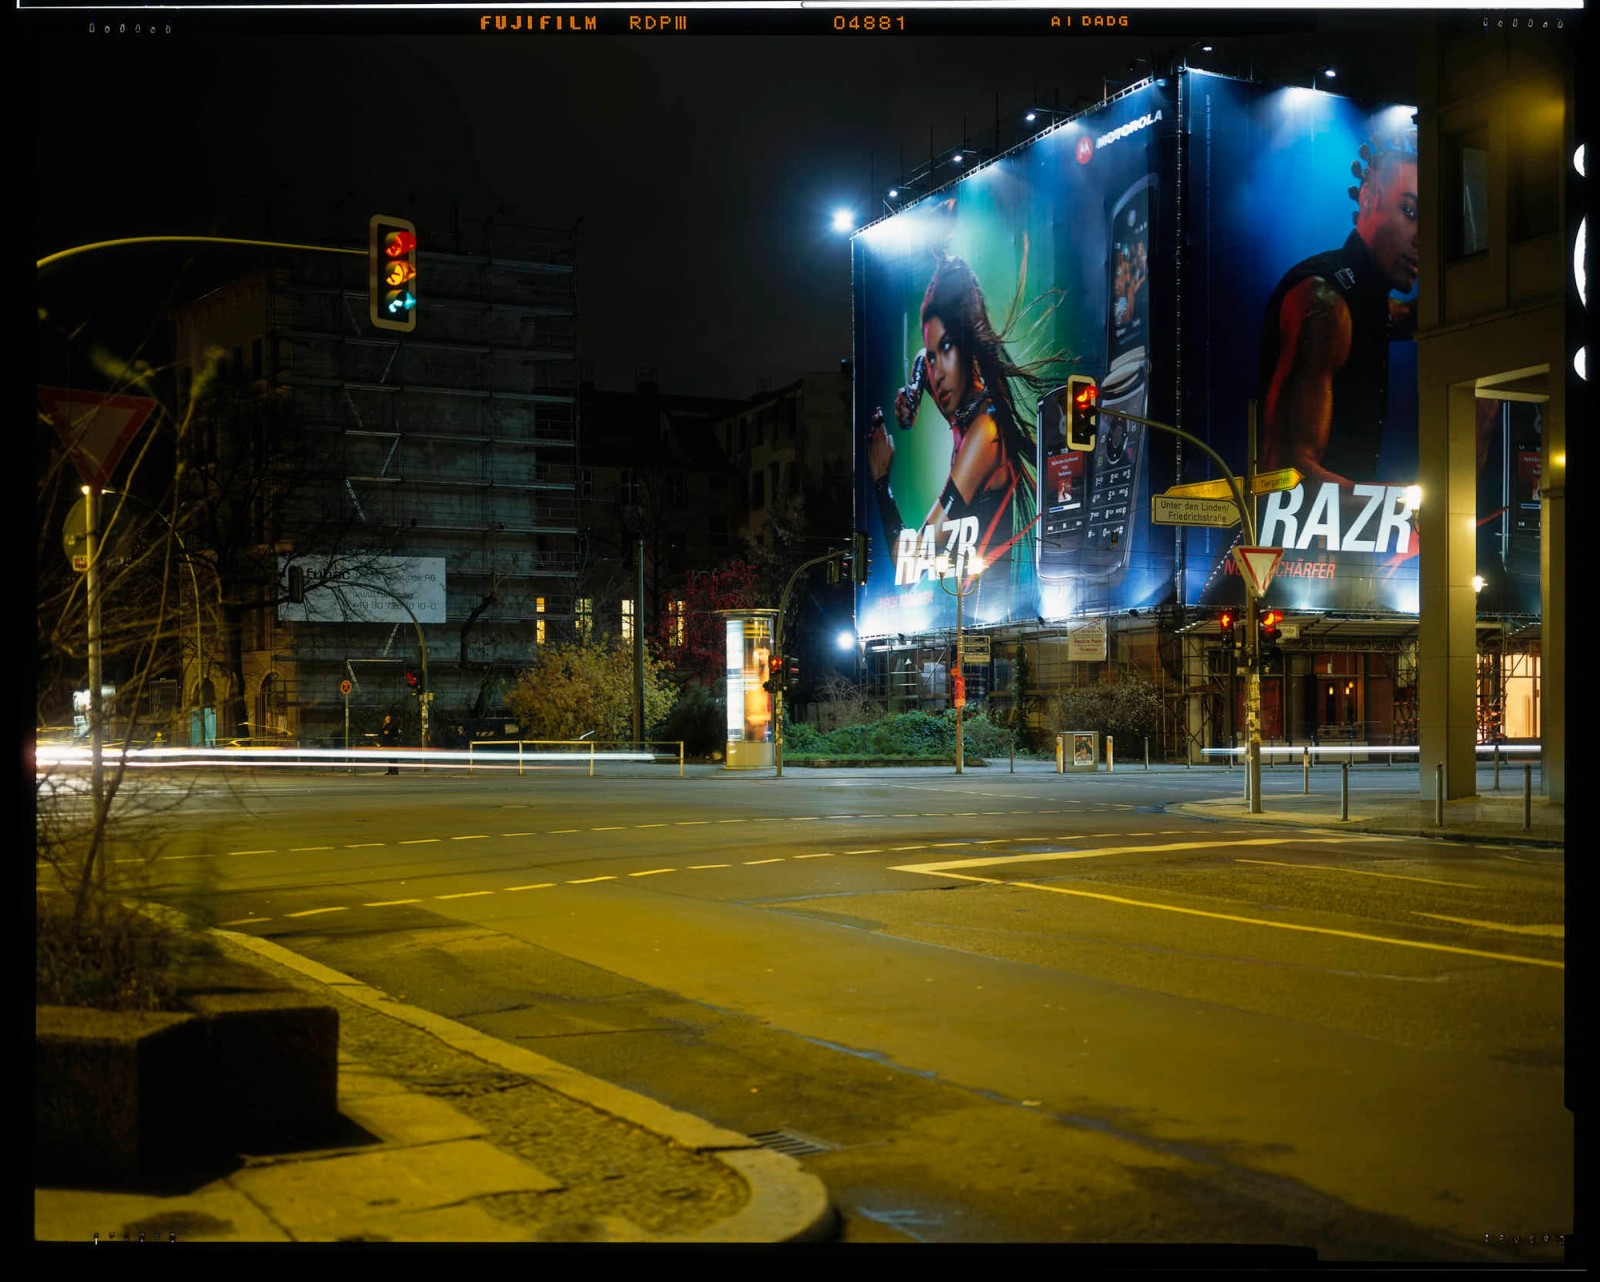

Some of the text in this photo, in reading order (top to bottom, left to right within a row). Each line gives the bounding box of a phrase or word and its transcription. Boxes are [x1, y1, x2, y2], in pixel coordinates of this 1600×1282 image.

[480, 15, 597, 31] FUJIFILM
[833, 15, 906, 31] 04881
[1081, 15, 1130, 28] DADG
[1095, 109, 1163, 150] MOTOROLA
[1260, 476, 1291, 489] Tiergarten
[1160, 500, 1230, 513] Unter den Linden/
[1168, 511, 1228, 524] Friedrichstraße
[1258, 482, 1415, 554] RAZR
[894, 515, 980, 586] RAZR
[1274, 557, 1337, 580] CHÄRFER
